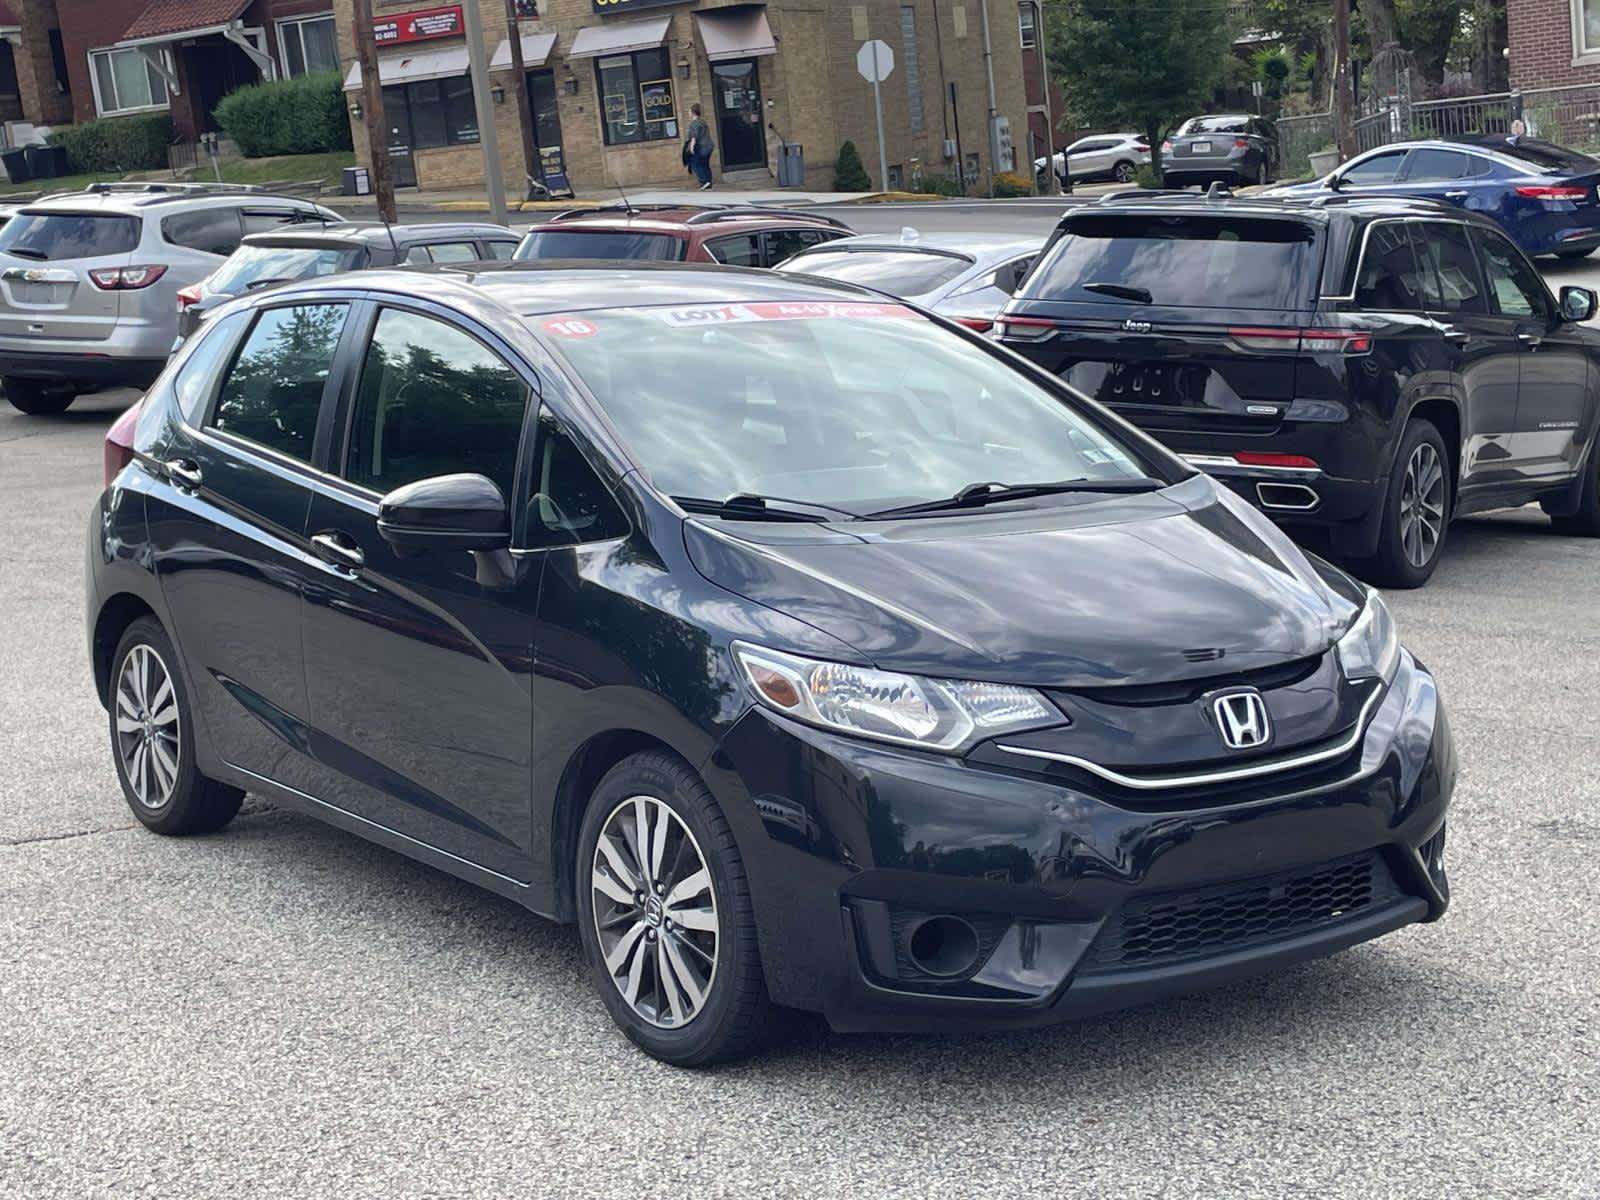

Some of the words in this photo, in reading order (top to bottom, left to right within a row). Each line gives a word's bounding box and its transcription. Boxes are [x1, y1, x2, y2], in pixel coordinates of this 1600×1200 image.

[646, 95, 671, 107] GOLD
[551, 320, 592, 335] 16
[1122, 319, 1151, 333] Jeep
